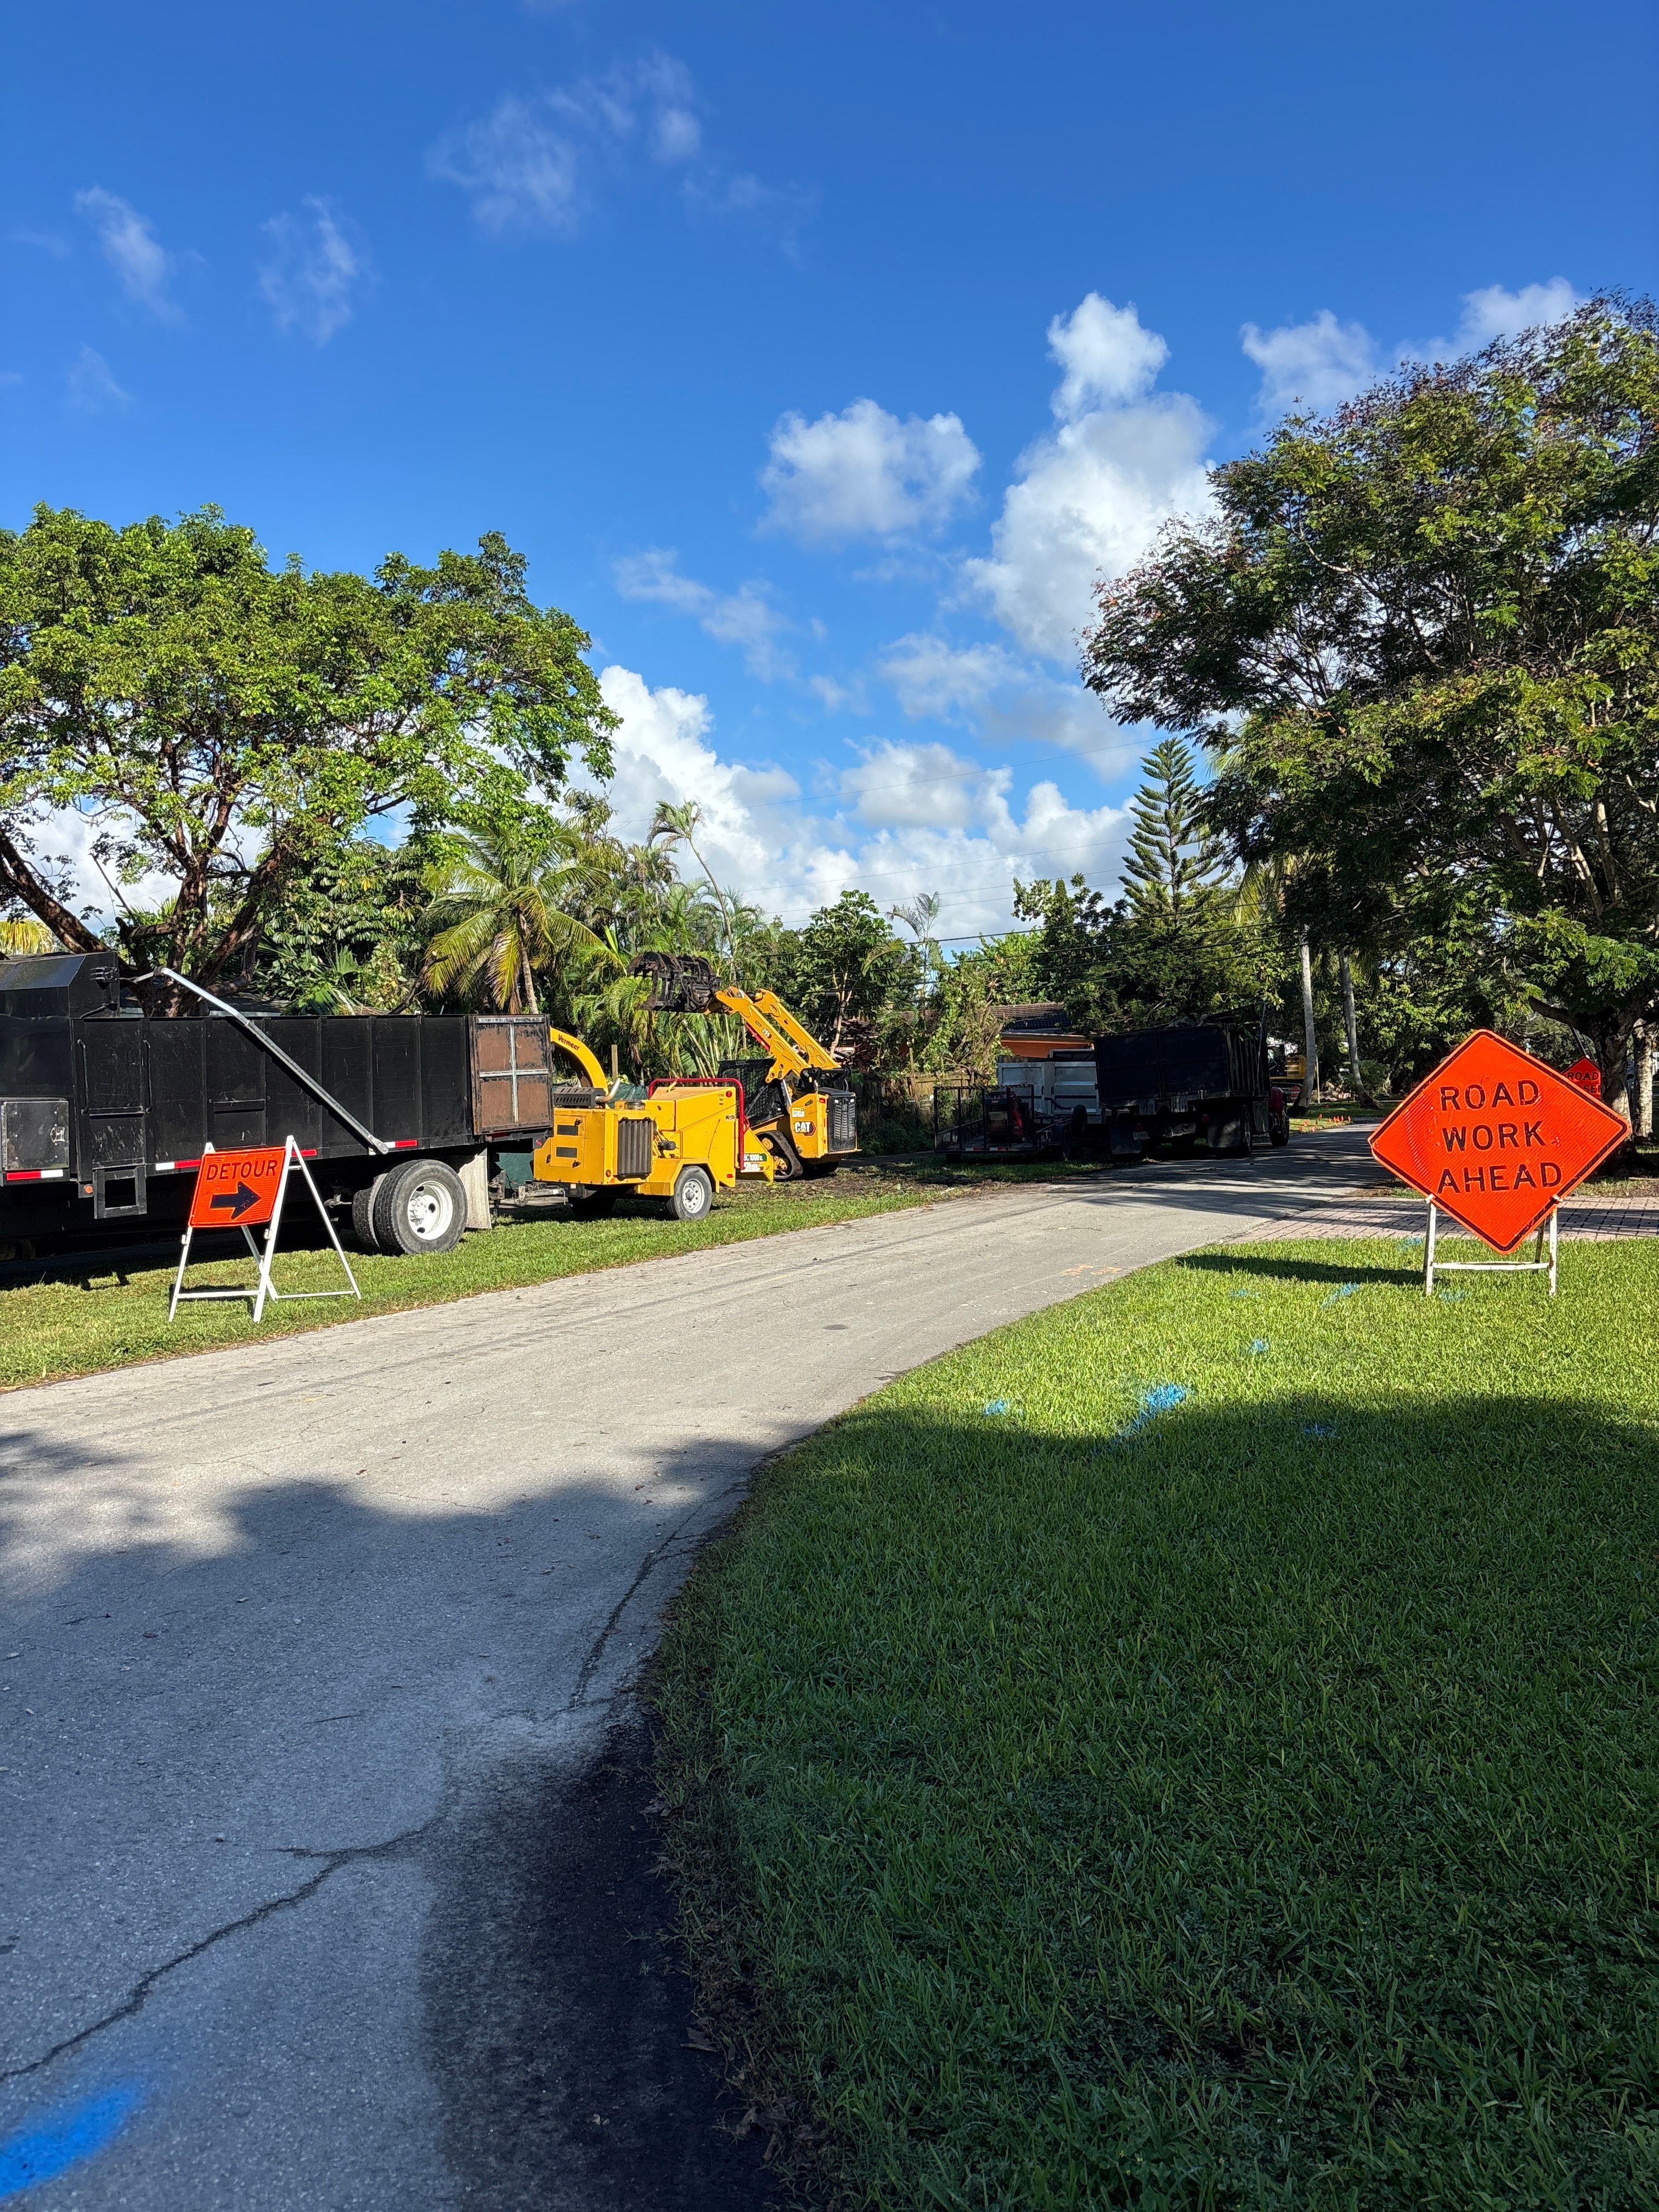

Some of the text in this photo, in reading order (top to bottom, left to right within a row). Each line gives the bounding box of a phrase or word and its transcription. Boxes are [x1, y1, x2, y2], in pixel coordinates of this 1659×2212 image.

[558, 1034, 579, 1051] Vermeer
[1567, 1071, 1599, 1081] ROAD
[1440, 1080, 1539, 1111] ROAD
[794, 1121, 811, 1133] CAT
[1442, 1120, 1547, 1152] WORK
[206, 1159, 278, 1180] DETOUR
[1437, 1162, 1562, 1194] AHEAD
